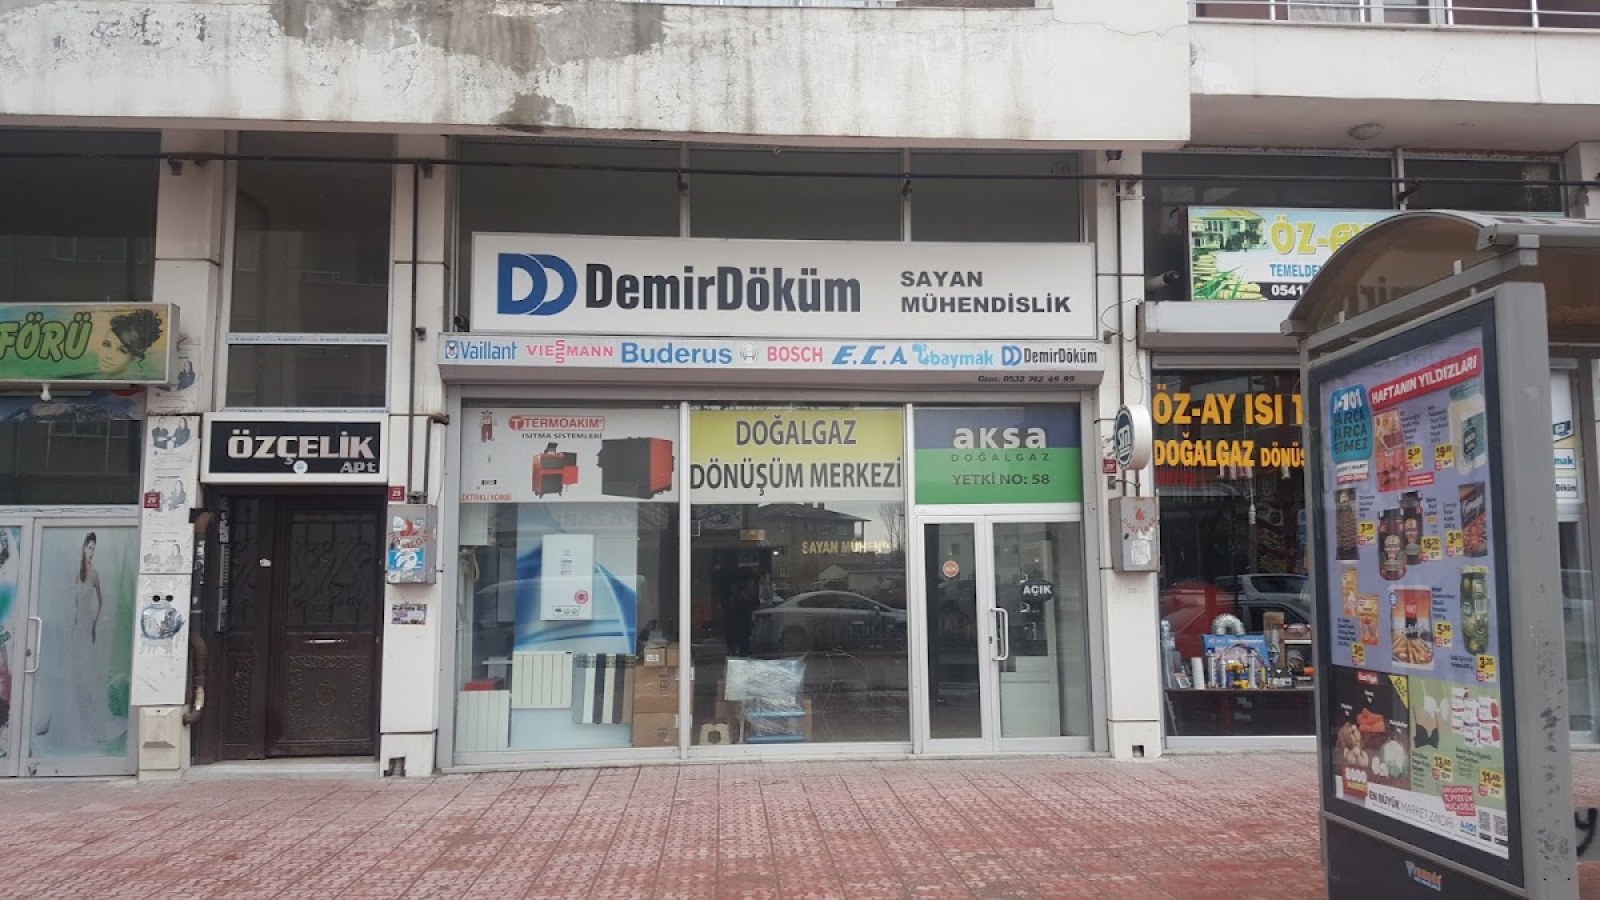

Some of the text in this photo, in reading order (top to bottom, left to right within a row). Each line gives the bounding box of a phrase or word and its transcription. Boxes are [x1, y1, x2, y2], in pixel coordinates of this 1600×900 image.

[900, 271, 983, 288] SAYAN
[1270, 263, 1323, 277] TEMELDE
[586, 263, 861, 313] DemirDöküm
[1271, 284, 1304, 296] 0541
[900, 292, 1072, 313] MÜHENDİSLİK
[0, 311, 93, 361] FÖRÜ
[460, 341, 518, 361] Vaillant
[621, 342, 733, 364] Buderus
[767, 346, 823, 363] BOSCH
[930, 351, 994, 368] baymak
[1023, 348, 1098, 365] DemirDöküm
[1371, 354, 1477, 405] HAFTANIN YILDIZLARI
[1152, 384, 1236, 425] ÖZ-AY
[1244, 393, 1283, 425] ISI
[524, 417, 600, 429] TERMOAKIM
[736, 414, 857, 446] DOĞALGAZ
[227, 428, 375, 465] ÖZÇELİK
[952, 427, 1047, 449] aksa
[951, 451, 1050, 462] DOĞALGAZ
[1154, 432, 1255, 468] DOĞALGAZ
[690, 456, 902, 496] DÖNÜŞÜM MERKEZİ
[951, 473, 1050, 485] YETKİ NO: 58
[801, 541, 838, 554] SAYAN
[1023, 584, 1052, 596] AÇIK
